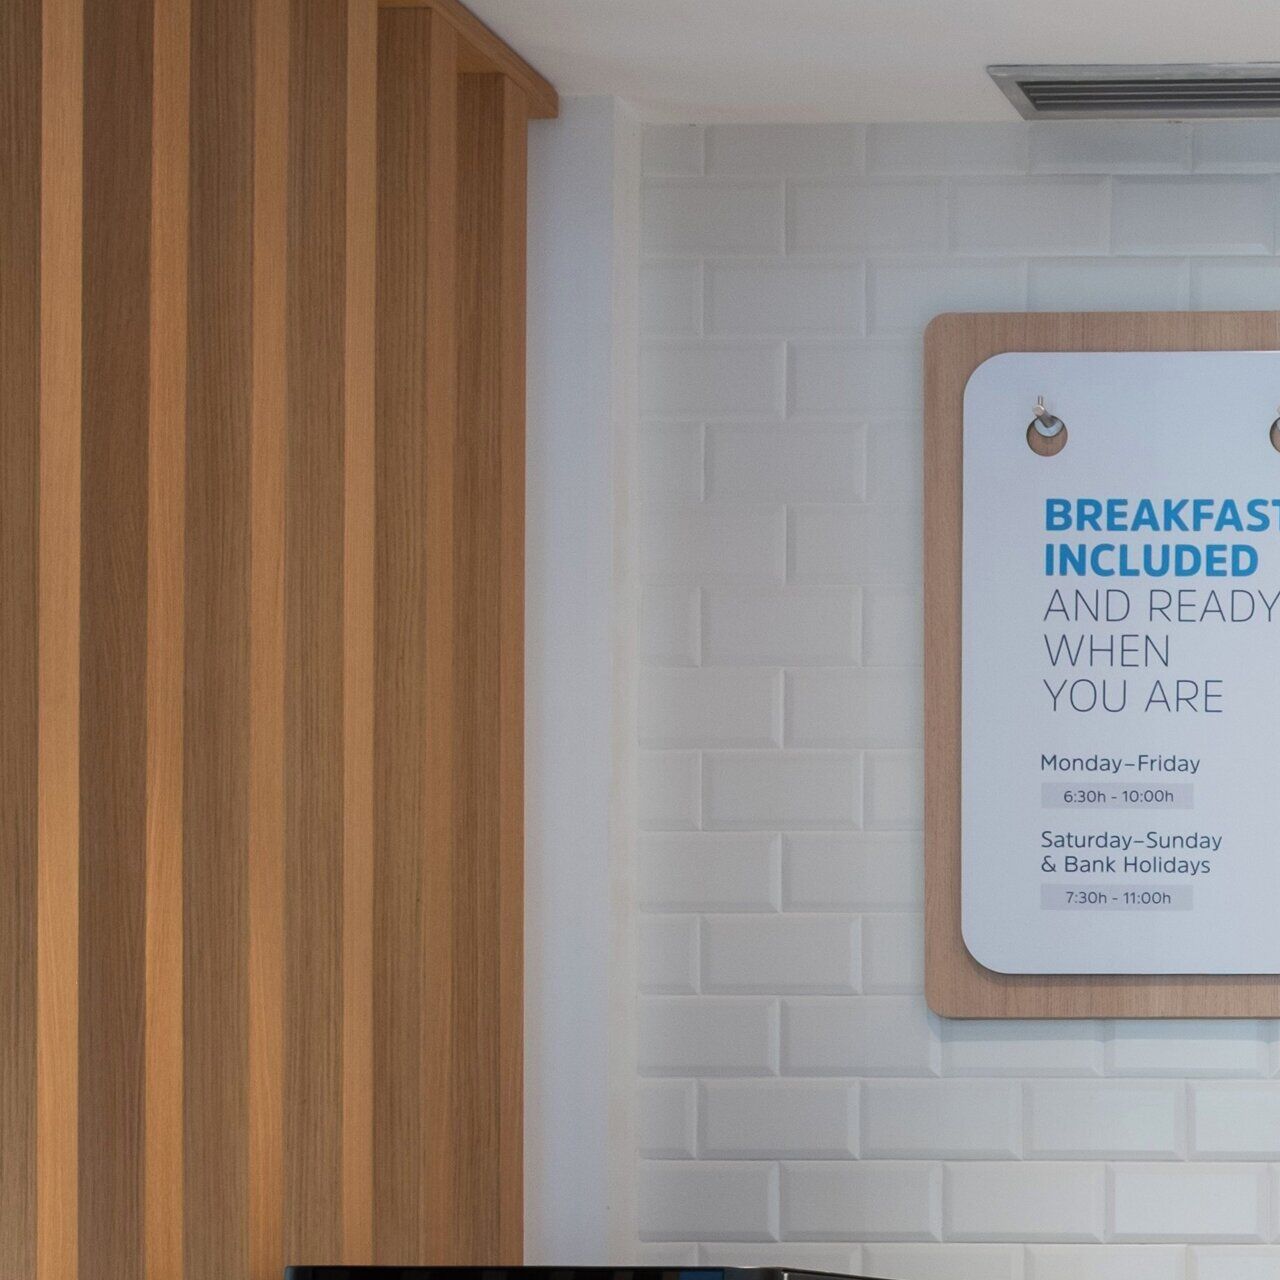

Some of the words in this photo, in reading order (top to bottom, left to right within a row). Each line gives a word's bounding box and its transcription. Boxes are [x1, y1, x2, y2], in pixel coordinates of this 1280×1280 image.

[1045, 543, 1258, 577] INCLUDED
[1044, 589, 1130, 621] AND
[1044, 634, 1168, 667] WHEN
[1043, 679, 1126, 712] YOU
[1145, 680, 1223, 712] ARE
[1064, 790, 1106, 803] 6:30h
[1122, 790, 1173, 802] 10:00h
[1041, 855, 1056, 872] &
[1065, 856, 1115, 872] Bank
[1124, 856, 1210, 875] Holidays
[1066, 892, 1107, 904] 7:30h
[1123, 892, 1171, 904] 11:00h
